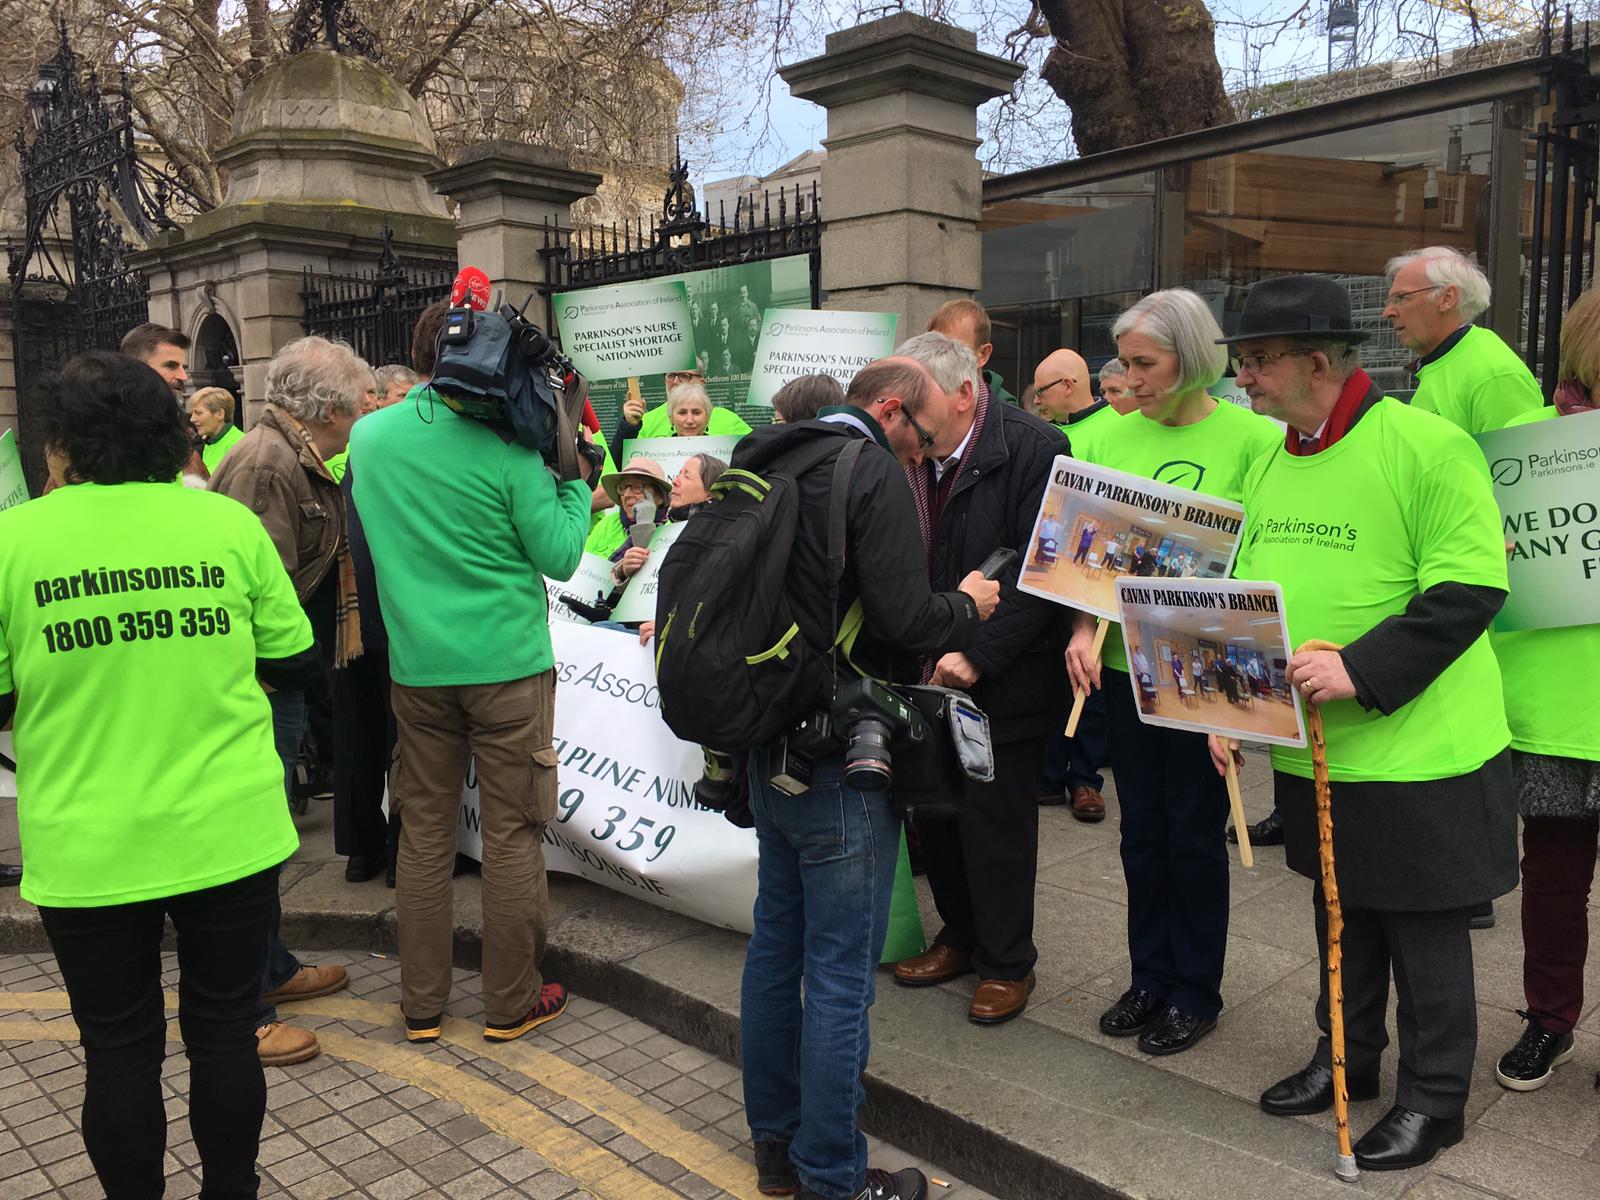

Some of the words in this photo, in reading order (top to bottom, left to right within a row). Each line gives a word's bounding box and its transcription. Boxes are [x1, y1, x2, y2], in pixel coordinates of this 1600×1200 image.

[573, 339, 627, 353] SPECIALIST
[629, 333, 683, 347] SHORTAGE
[574, 325, 642, 341] PARKINSON'S
[644, 321, 678, 334] NURSE
[596, 347, 664, 362] NATIONWIDE
[769, 351, 836, 364] PARKINSON'S
[763, 364, 817, 376] SPECIALIST
[819, 367, 856, 379] SHORT
[1528, 445, 1600, 469] Parkinso
[1530, 461, 1595, 478] Parkinsons.ie
[1054, 469, 1094, 496] CAVAN
[1094, 480, 1183, 519] PARKINSON'S
[1183, 505, 1243, 535] BRANCH
[1265, 516, 1358, 541] Parkinson's
[1503, 510, 1540, 534] WE
[1548, 502, 1598, 529] DO
[1302, 536, 1314, 545] of
[1316, 538, 1356, 552] Ireland
[1510, 533, 1570, 561] ANY
[34, 561, 225, 608] parkinsons.ie
[1120, 587, 1152, 605] CAVAN
[1153, 589, 1226, 609] PARKINSON'S
[1227, 592, 1279, 613] BRANCH
[42, 615, 114, 653] 1800
[118, 608, 173, 643] 359
[179, 606, 231, 637] 359
[590, 805, 676, 863] 359
